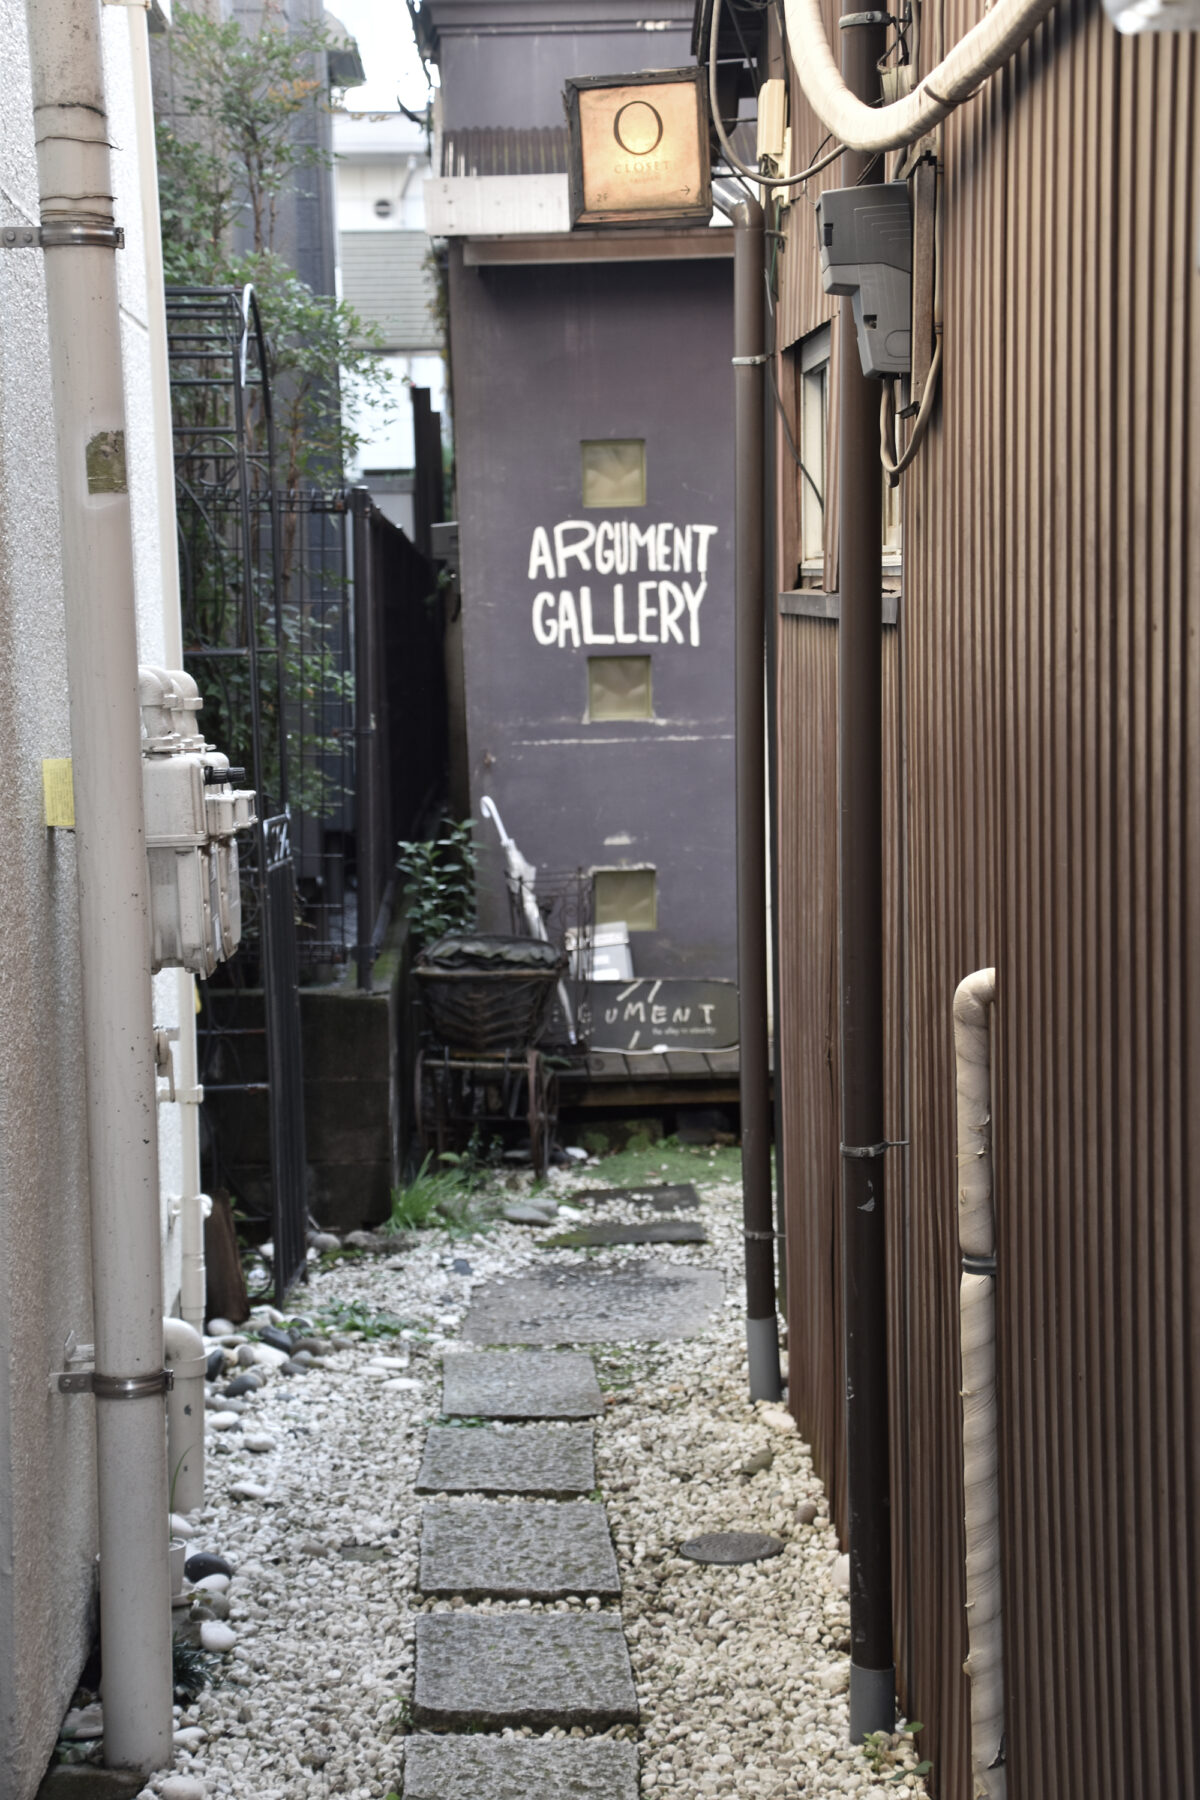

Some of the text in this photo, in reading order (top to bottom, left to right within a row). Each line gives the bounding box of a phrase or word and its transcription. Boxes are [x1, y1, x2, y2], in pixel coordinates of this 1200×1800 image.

[613, 160, 672, 175] CLOSET
[528, 520, 719, 579] ARGUMENT
[532, 580, 708, 648] GALLERY
